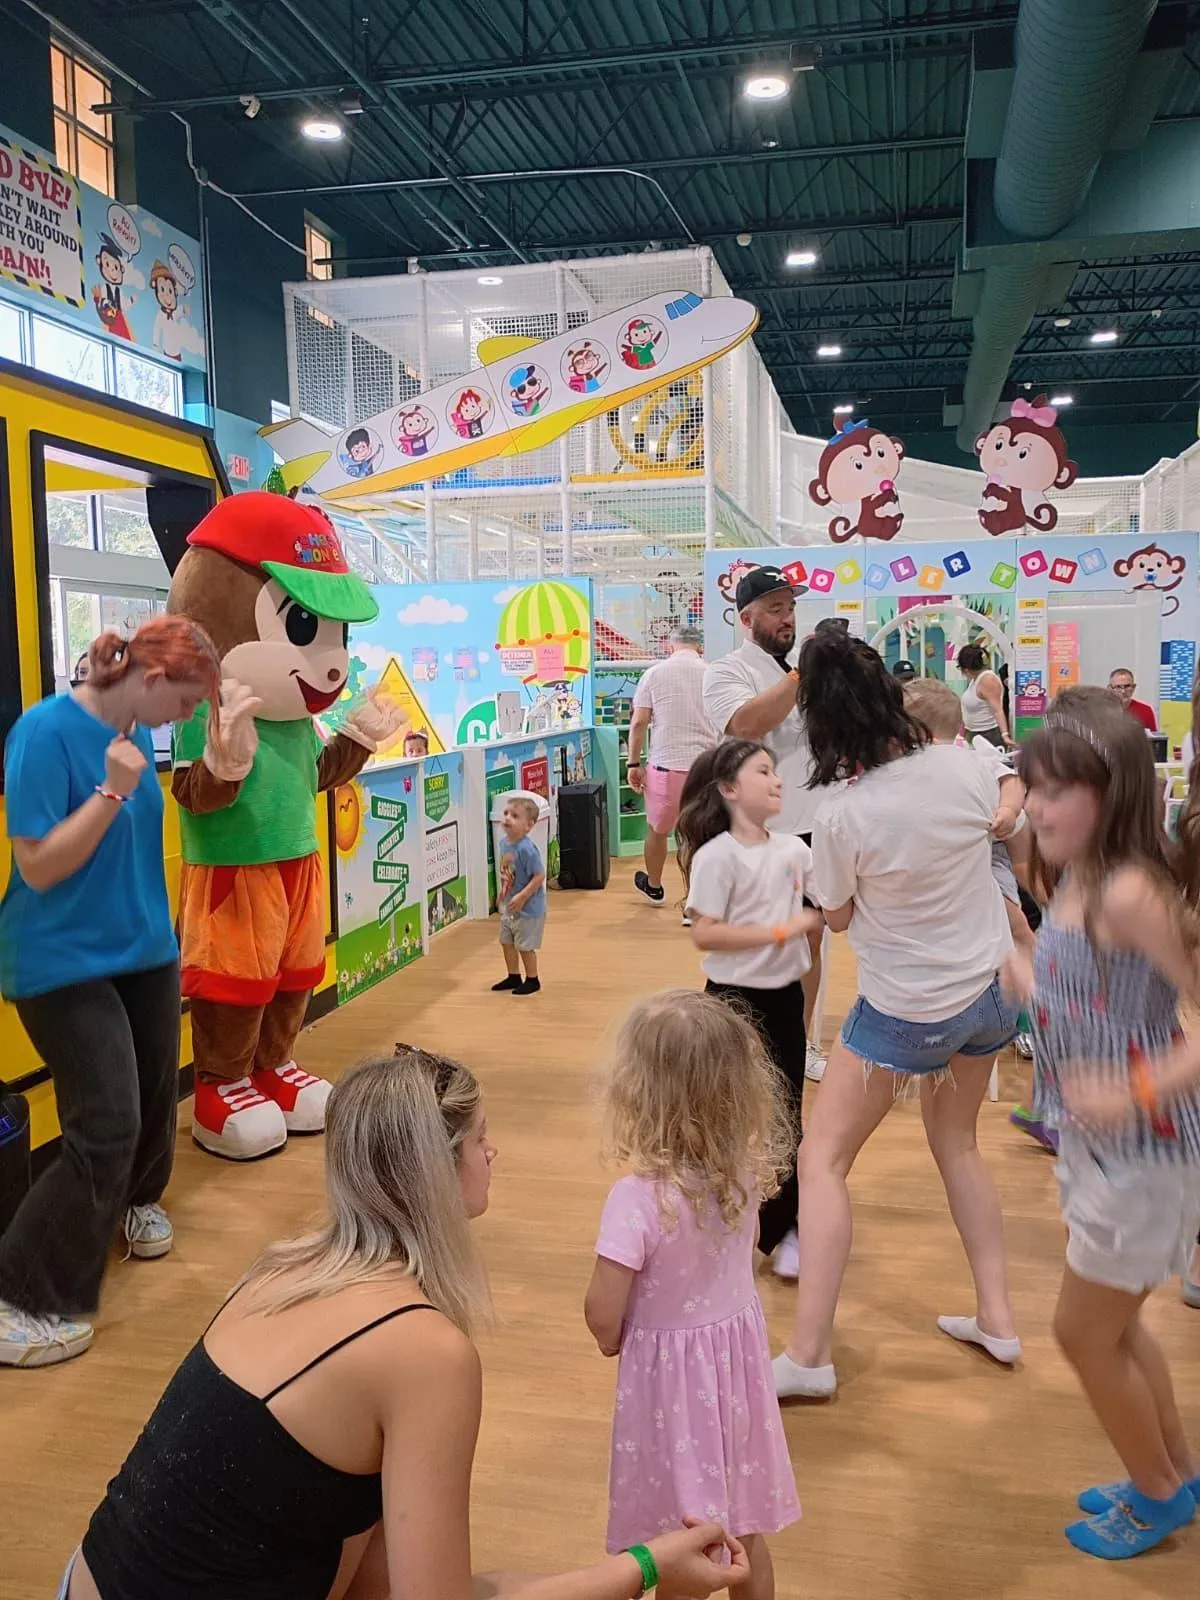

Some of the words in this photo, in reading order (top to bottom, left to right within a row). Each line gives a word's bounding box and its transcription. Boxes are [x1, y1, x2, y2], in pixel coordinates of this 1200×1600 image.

[19, 158, 72, 210] BYE!
[26, 197, 61, 226] WAIT
[18, 229, 45, 254] YOU
[25, 215, 78, 252] AROUND
[0, 245, 52, 286] AIN!!
[234, 456, 248, 478] EXIT
[786, 557, 964, 587] TODDLER
[999, 554, 1101, 582] TOWN
[428, 776, 445, 791] SORRY
[377, 801, 398, 819] GIGGLES
[377, 865, 404, 880] CELEBRATE
